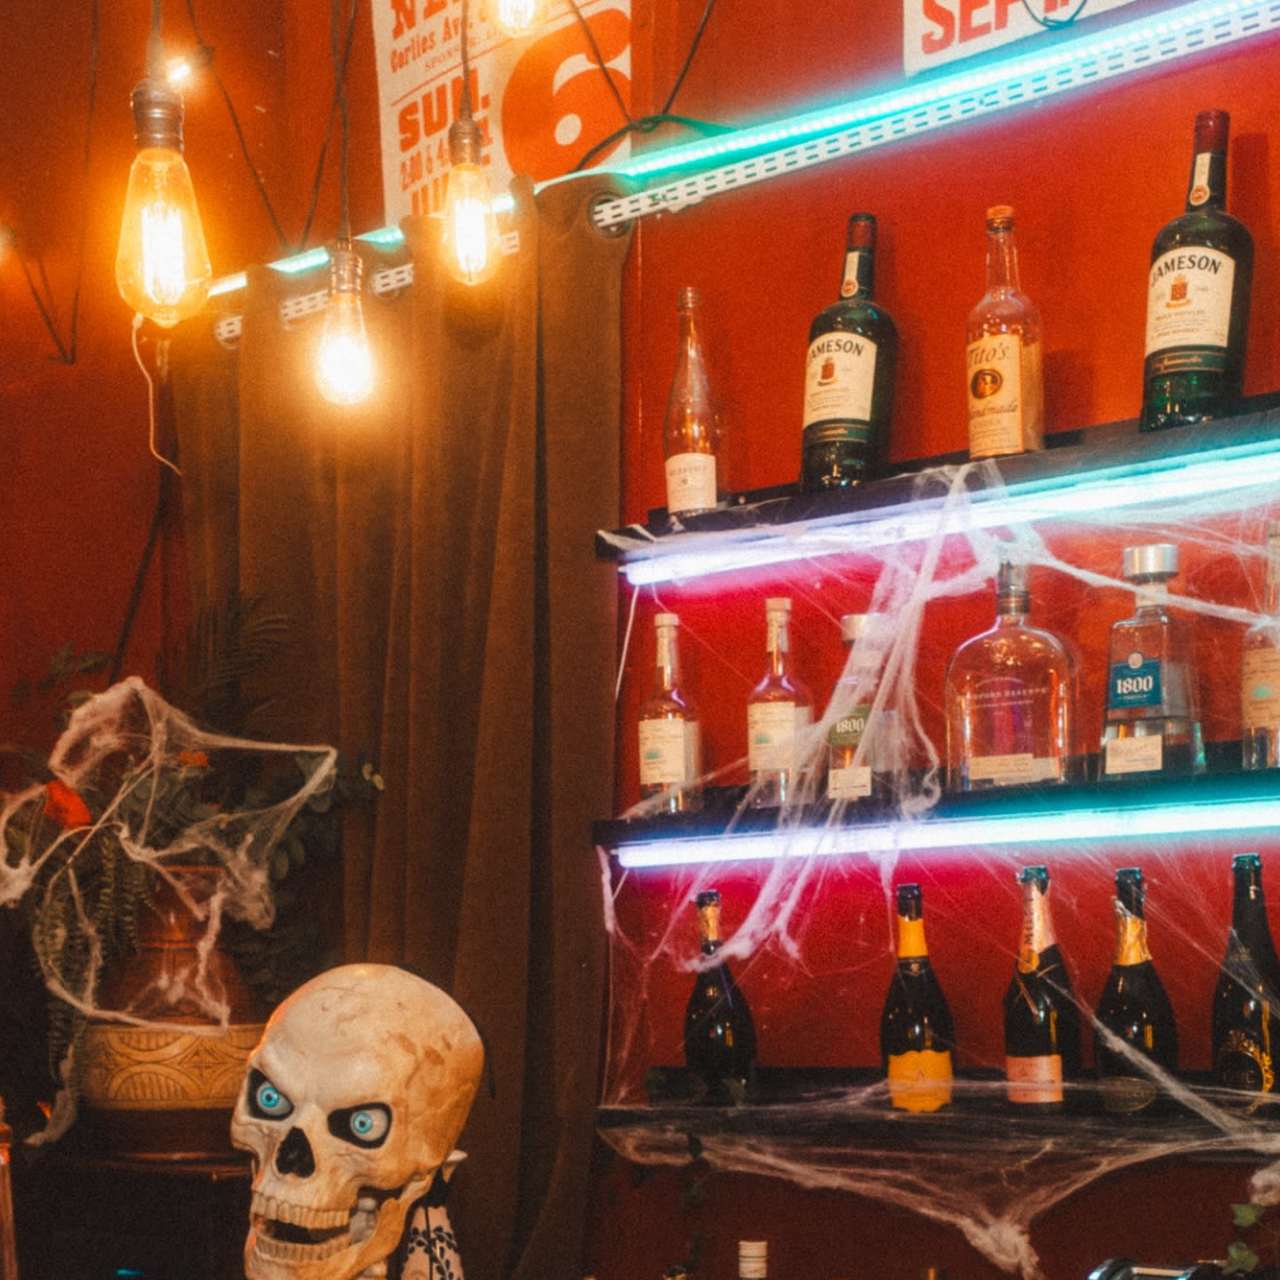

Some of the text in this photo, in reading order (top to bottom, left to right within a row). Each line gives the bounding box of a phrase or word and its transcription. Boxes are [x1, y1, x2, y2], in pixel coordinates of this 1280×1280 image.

[1151, 253, 1222, 288] JAMESON
[808, 339, 864, 360] AMESON
[1116, 675, 1154, 695] 1800
[836, 717, 864, 733] 1800
